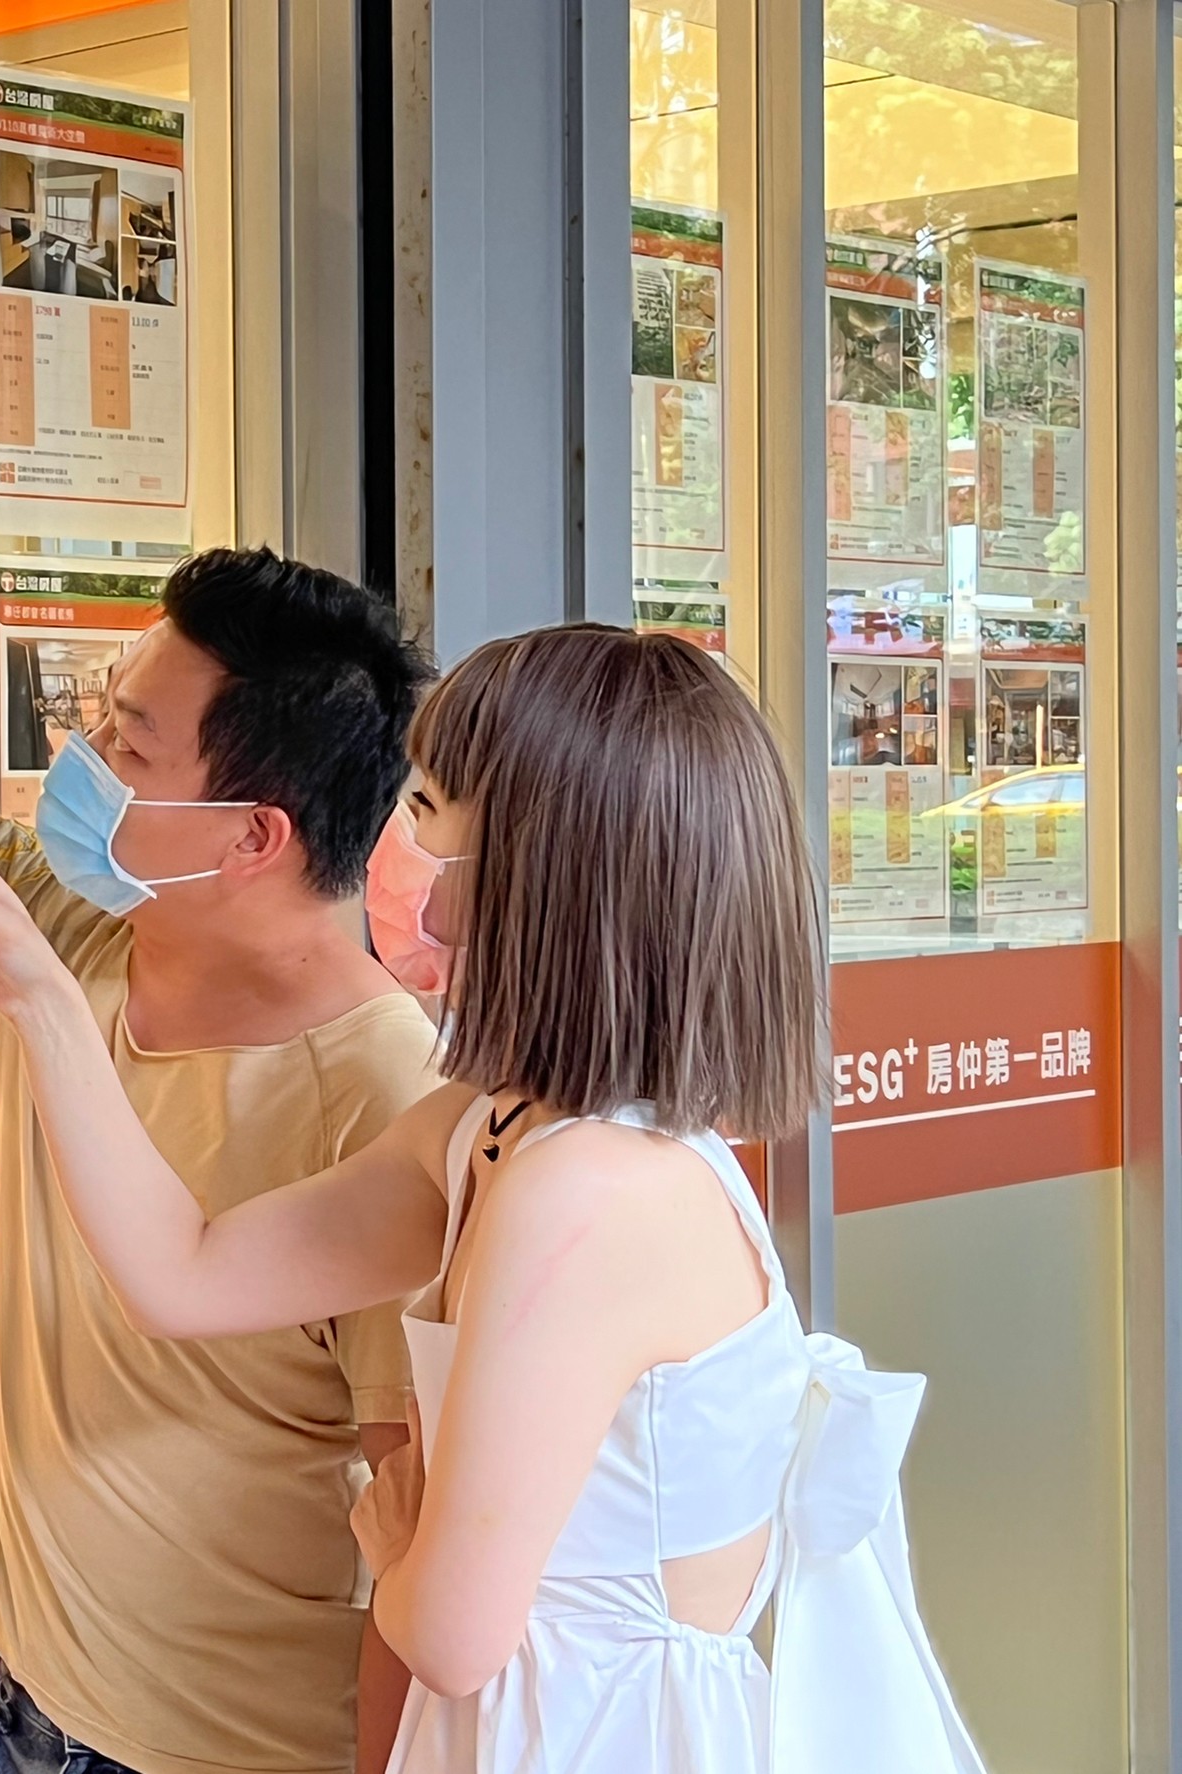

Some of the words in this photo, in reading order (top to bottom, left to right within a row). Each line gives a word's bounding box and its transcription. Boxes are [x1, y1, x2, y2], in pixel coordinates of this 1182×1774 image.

[927, 1027, 1091, 1094] 房仲第一品牌
